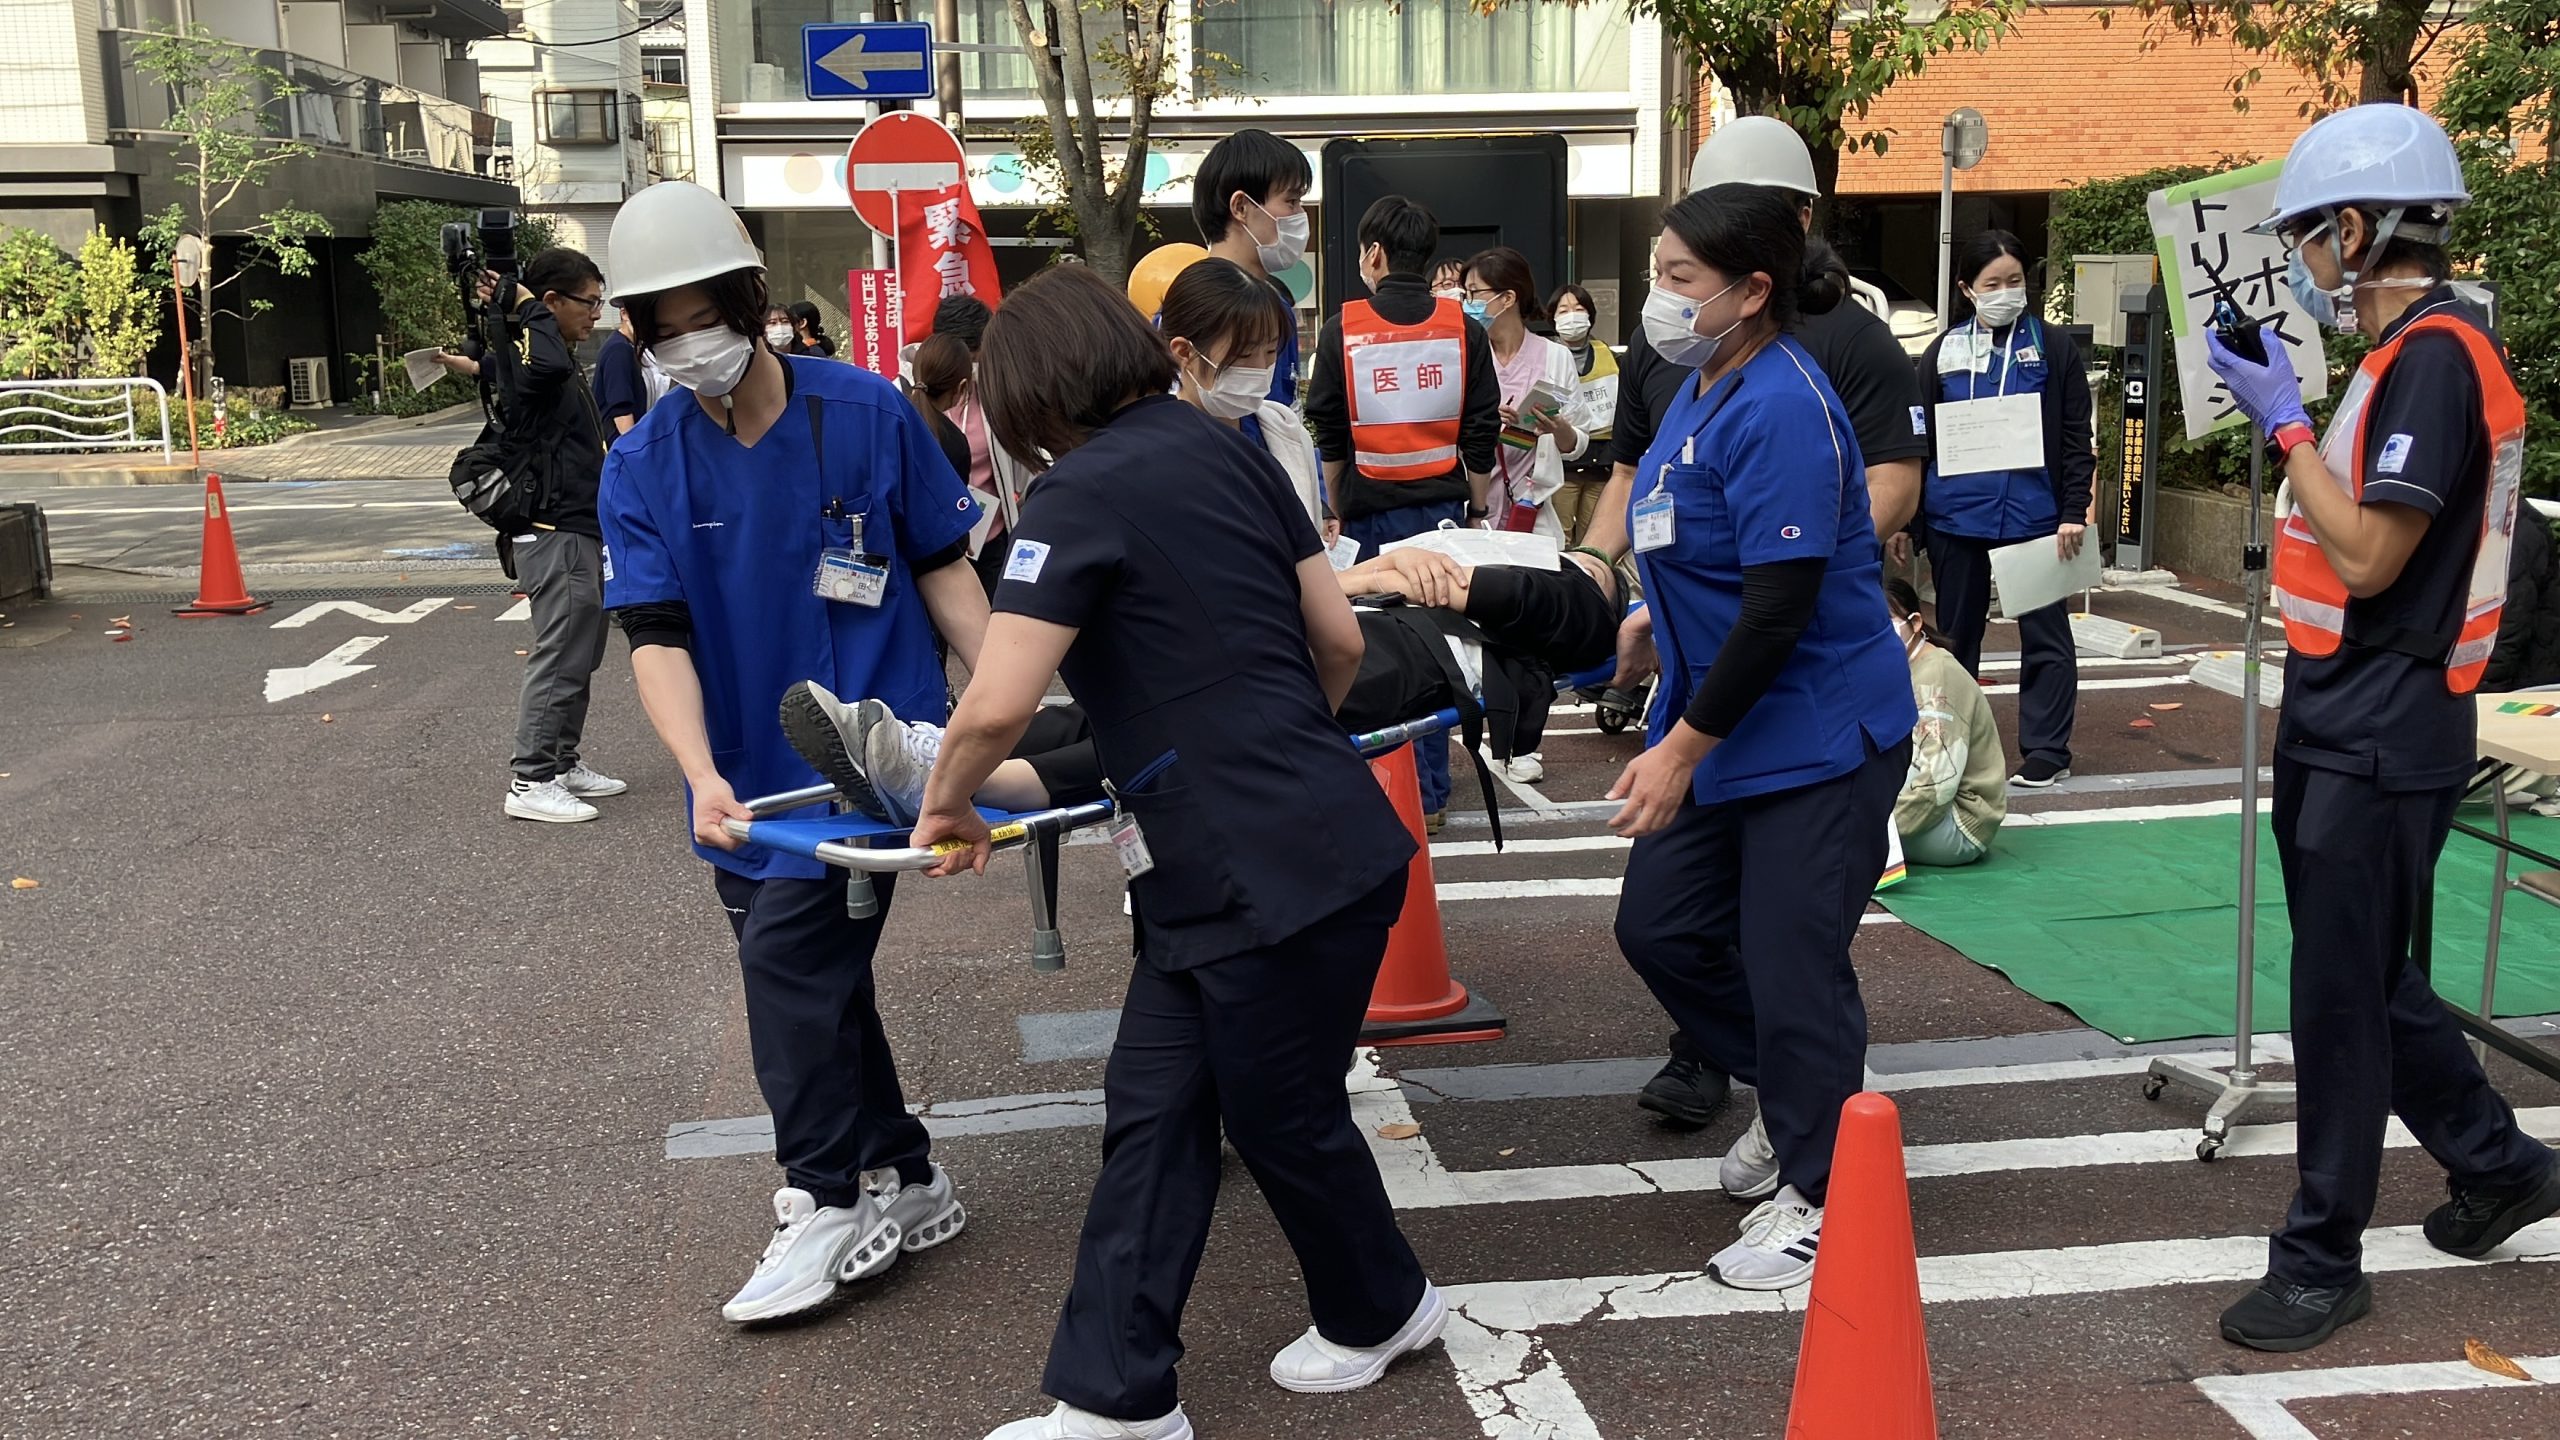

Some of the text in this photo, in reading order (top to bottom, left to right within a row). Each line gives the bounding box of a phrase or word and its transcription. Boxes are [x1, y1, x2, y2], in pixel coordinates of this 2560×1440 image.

[924, 198, 976, 299] 緊急
[862, 272, 881, 374] 出口ではありま
[1373, 362, 1444, 395] 医師
[2121, 418, 2135, 535] 駐車料金をお支払いください
